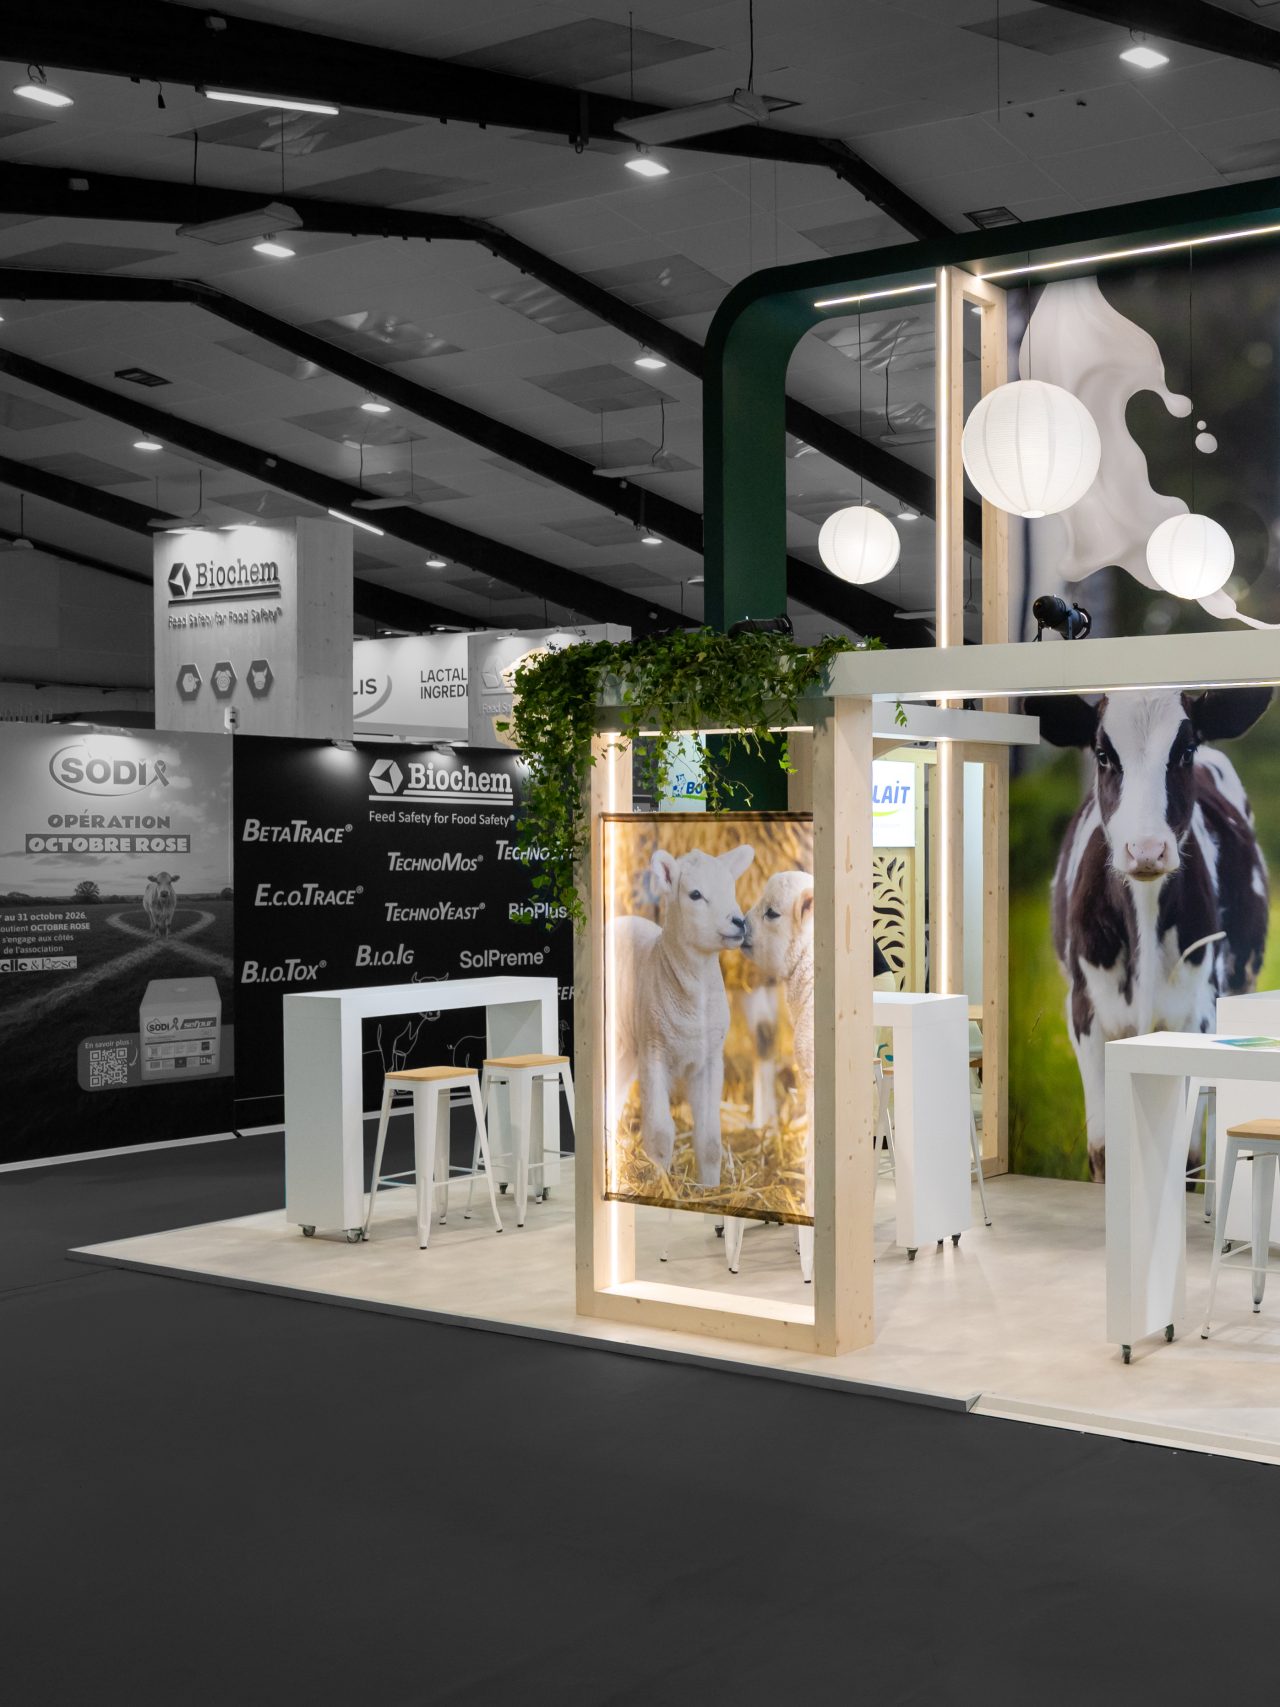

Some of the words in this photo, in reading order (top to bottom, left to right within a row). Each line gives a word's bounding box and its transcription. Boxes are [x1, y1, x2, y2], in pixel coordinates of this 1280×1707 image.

[195, 560, 280, 588] Biochem
[168, 614, 187, 630] Feed
[189, 611, 212, 630] Safety
[214, 611, 226, 626] for
[228, 609, 249, 625] Food
[408, 762, 513, 794] Biochem
[48, 809, 170, 830] OPÉRATION
[369, 810, 396, 823] Feed
[398, 810, 432, 827] Safety
[434, 811, 449, 825] for
[451, 812, 477, 826] Food
[28, 837, 131, 853] OCTOBRE
[135, 837, 188, 852] ROSE
[4, 914, 16, 922] au
[17, 913, 29, 921] 31
[30, 912, 64, 921] octobre
[30, 923, 69, 932] OCTOBRE
[70, 922, 91, 931] ROSE
[2, 935, 37, 945] s'engage
[54, 933, 74, 942] côtés
[3, 946, 14, 955] de
[15, 944, 64, 955] l'association
[95, 1040, 115, 1048] savoir
[115, 1039, 130, 1047] plus
